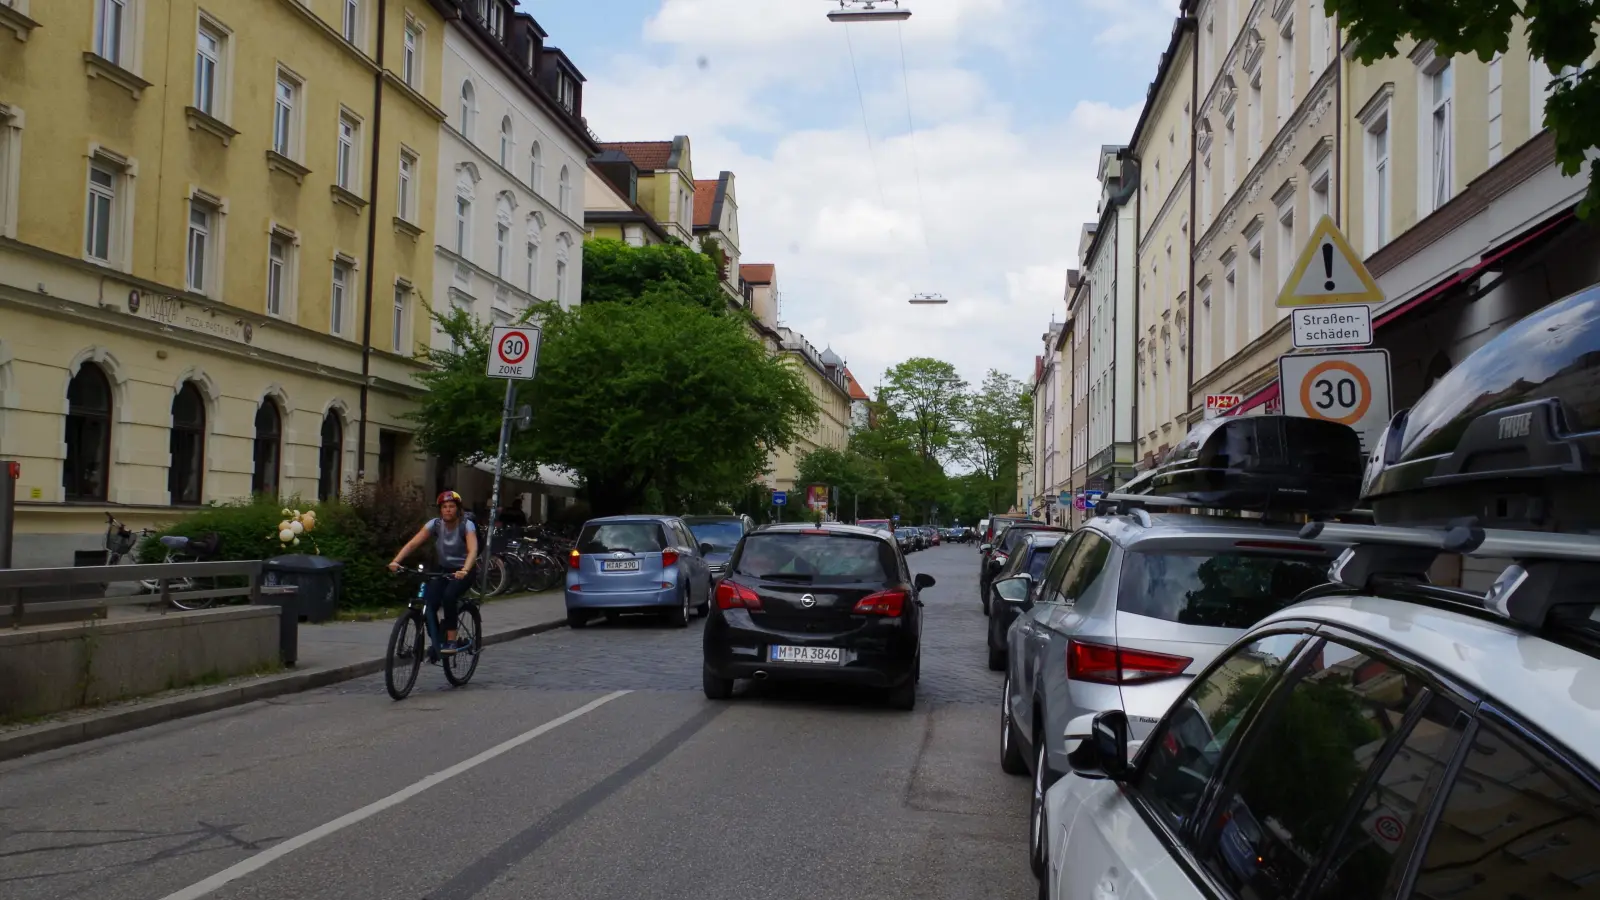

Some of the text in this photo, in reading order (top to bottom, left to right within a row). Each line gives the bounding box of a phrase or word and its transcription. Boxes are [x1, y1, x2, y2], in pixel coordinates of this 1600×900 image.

[1303, 313, 1360, 326] Straßen-
[1306, 328, 1360, 340] schäden
[504, 339, 523, 356] 30
[498, 365, 523, 375] ZONE
[1314, 378, 1356, 409] 30
[1206, 395, 1241, 409] PIZZA
[1498, 411, 1533, 440] THULE
[623, 561, 636, 569] 190
[779, 646, 838, 660] M PA 3846
